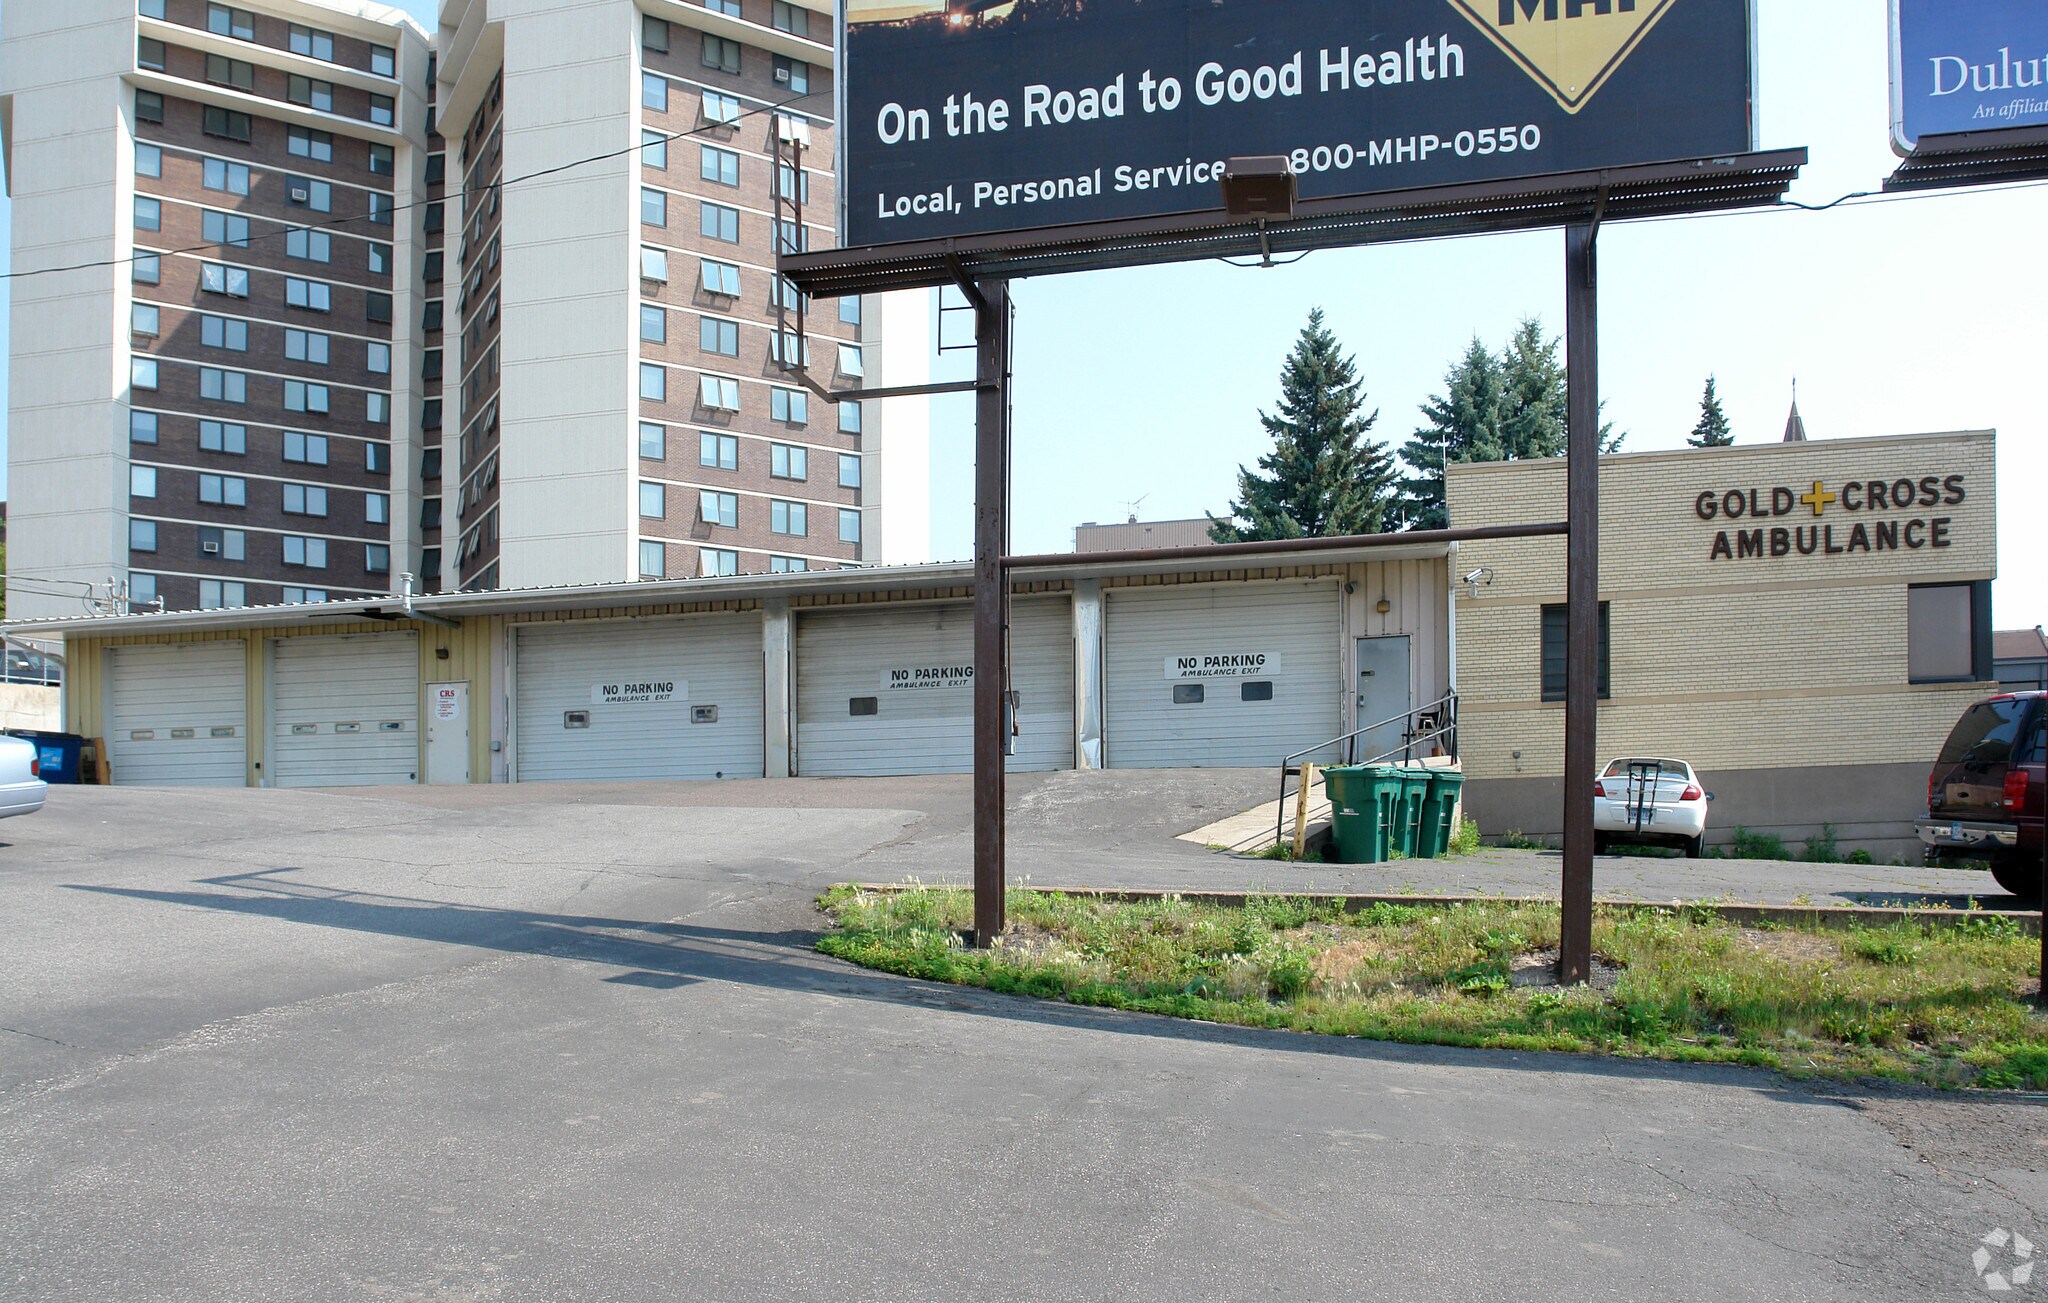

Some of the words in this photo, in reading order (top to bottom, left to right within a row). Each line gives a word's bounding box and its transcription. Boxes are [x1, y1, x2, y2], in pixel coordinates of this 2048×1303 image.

[877, 102, 930, 144] On
[943, 92, 1009, 137] the
[1024, 73, 1124, 127] Road
[1138, 69, 1182, 112] to
[1195, 51, 1302, 105] Good
[1319, 33, 1464, 92] Health
[1972, 104, 1995, 119] An
[878, 185, 961, 218] Local,
[974, 168, 1100, 207] Personal
[1114, 158, 1226, 191] Service
[1290, 124, 1541, 174] 800-MHP-0550
[1695, 487, 1795, 520] GOLD
[1842, 475, 1965, 510] CROSS
[1710, 517, 1951, 560] AMBULANCE
[1178, 657, 1197, 668] NO
[1204, 654, 1265, 667] PARKING
[891, 670, 909, 680] NO
[915, 666, 974, 680] PARKING
[1180, 668, 1237, 677] AMBULANCE
[602, 684, 618, 695] NO
[624, 681, 673, 694] PARKING
[890, 680, 941, 689] AMBULANCE
[948, 679, 968, 687] EXIT
[605, 694, 649, 703] AMBULANCE
